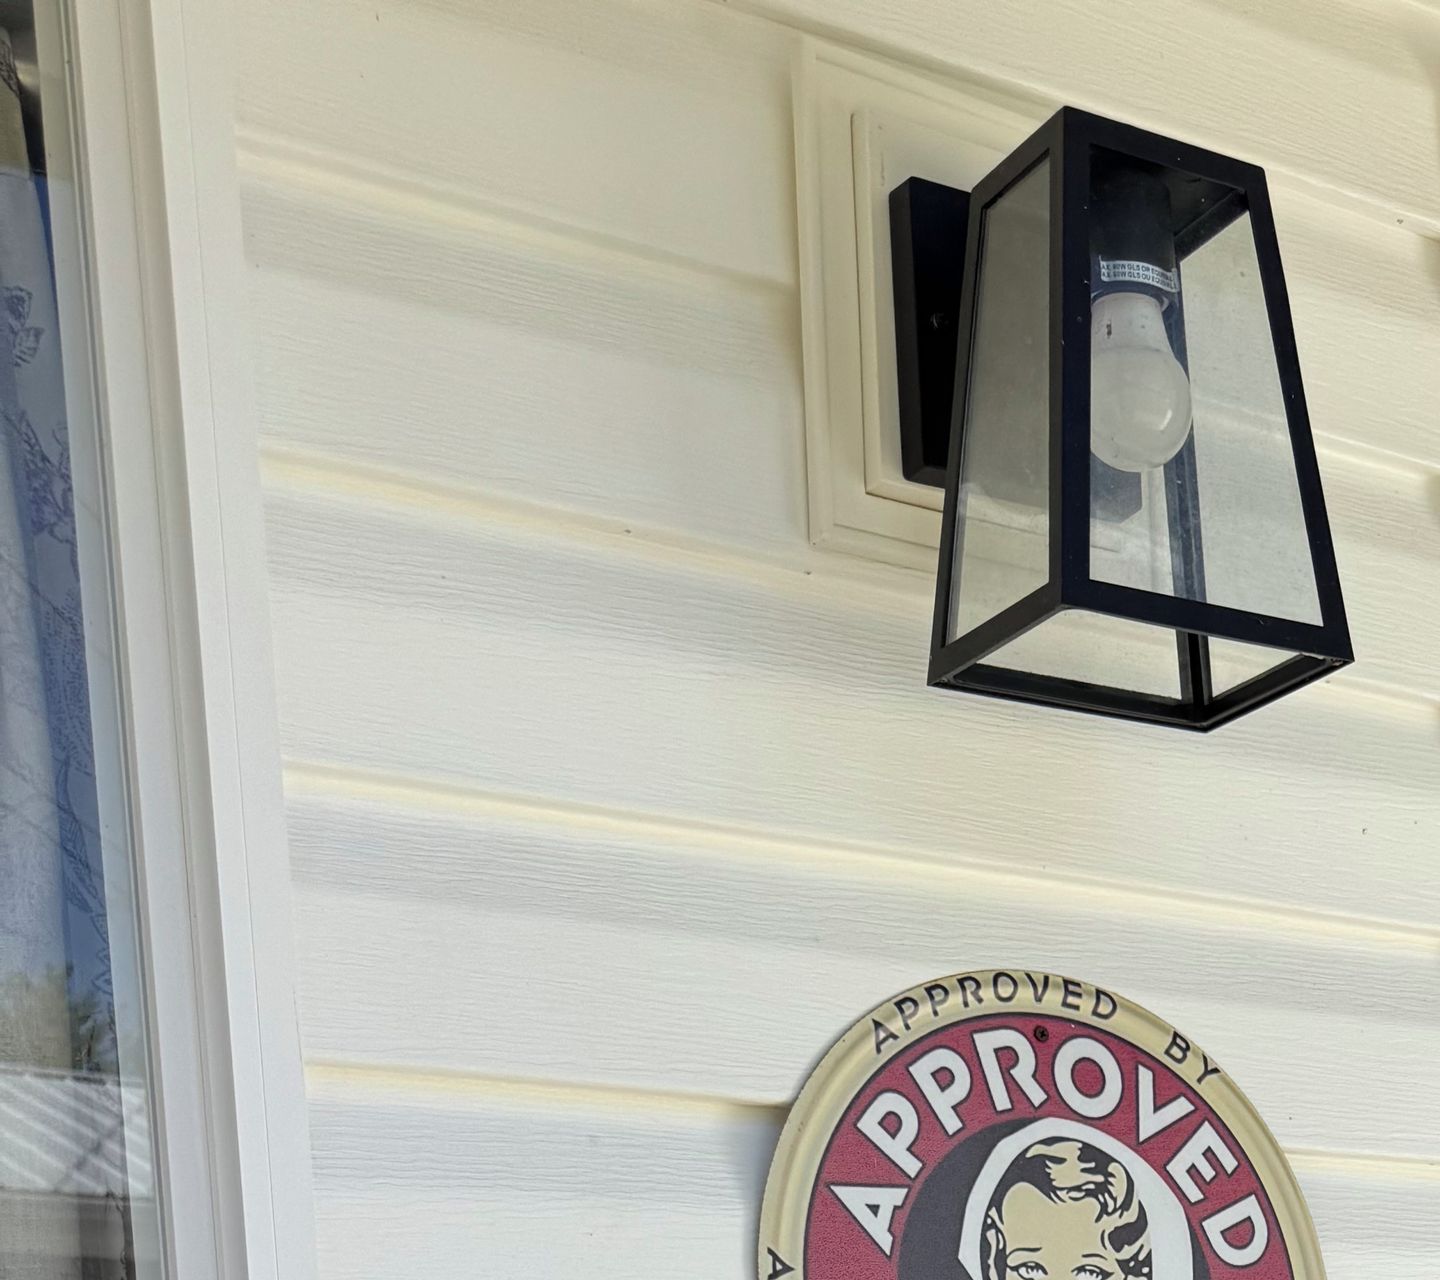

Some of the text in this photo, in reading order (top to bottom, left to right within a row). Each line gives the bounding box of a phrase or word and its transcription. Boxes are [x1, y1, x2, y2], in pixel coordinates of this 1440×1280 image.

[872, 971, 1222, 1085] APPROVED BY
[829, 1028, 1270, 1268] APPROVED
